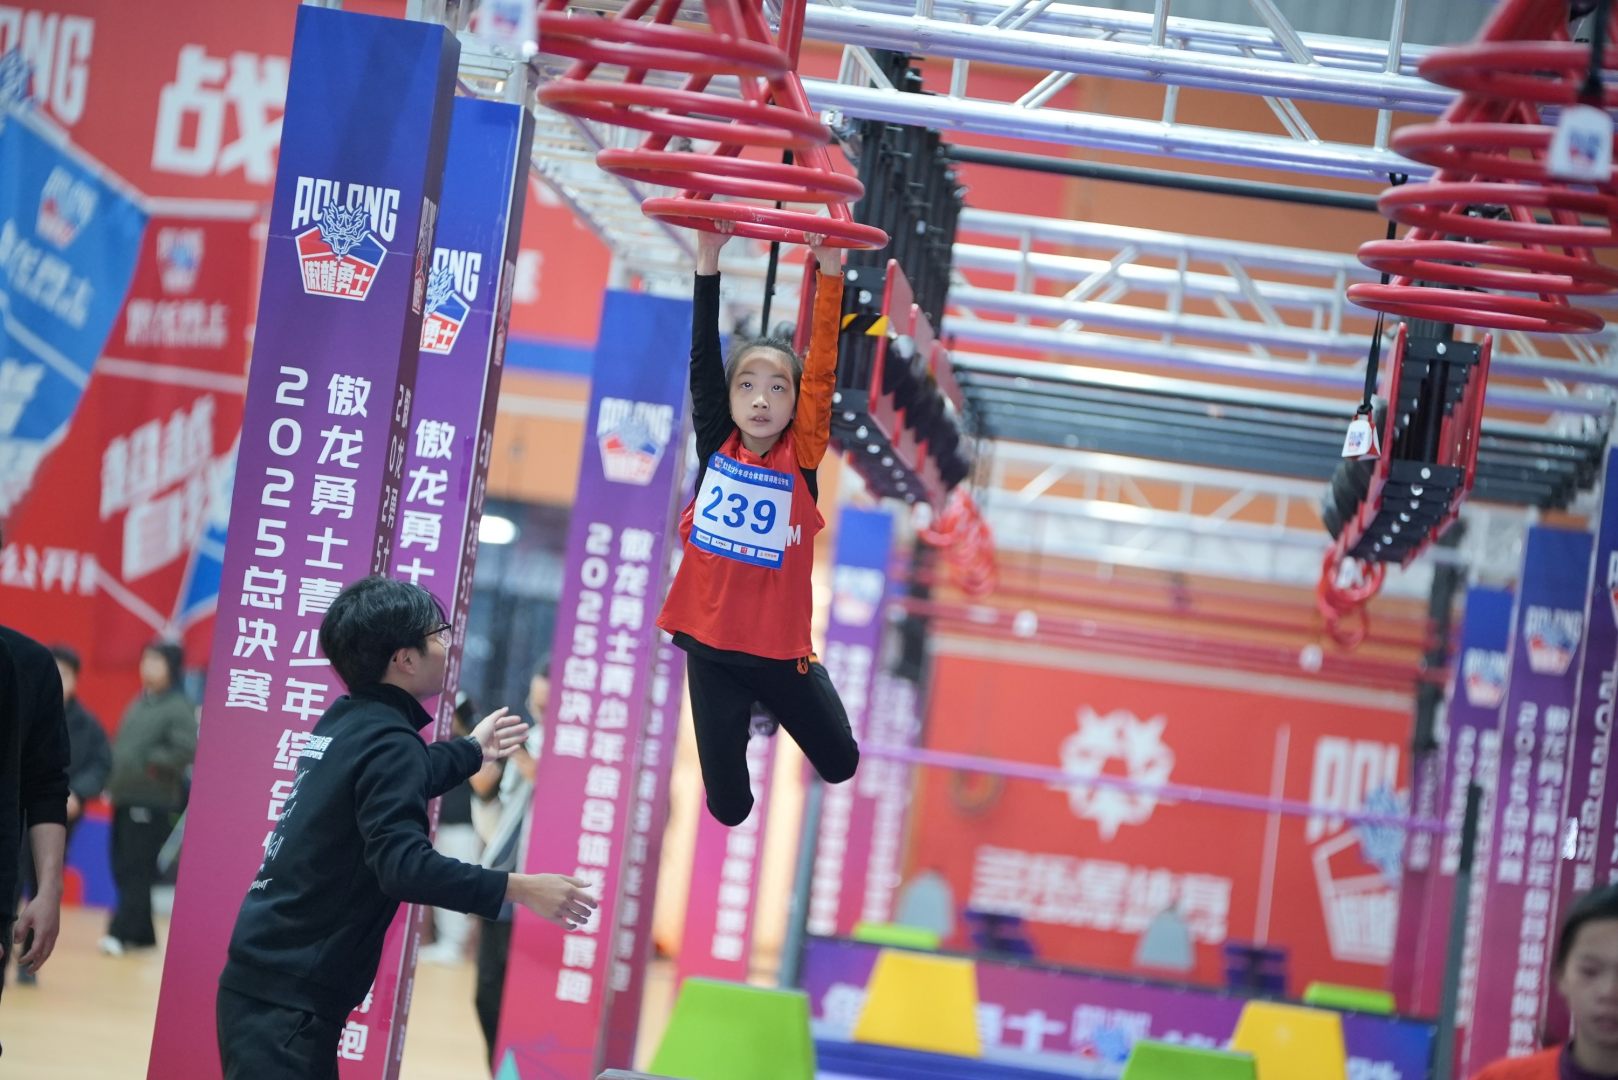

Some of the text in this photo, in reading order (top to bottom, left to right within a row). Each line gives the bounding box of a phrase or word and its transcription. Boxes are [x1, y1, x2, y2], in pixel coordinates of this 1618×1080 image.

[291, 176, 400, 242] AOLONG
[226, 366, 309, 712] 2025总决赛
[702, 486, 776, 534] 239
